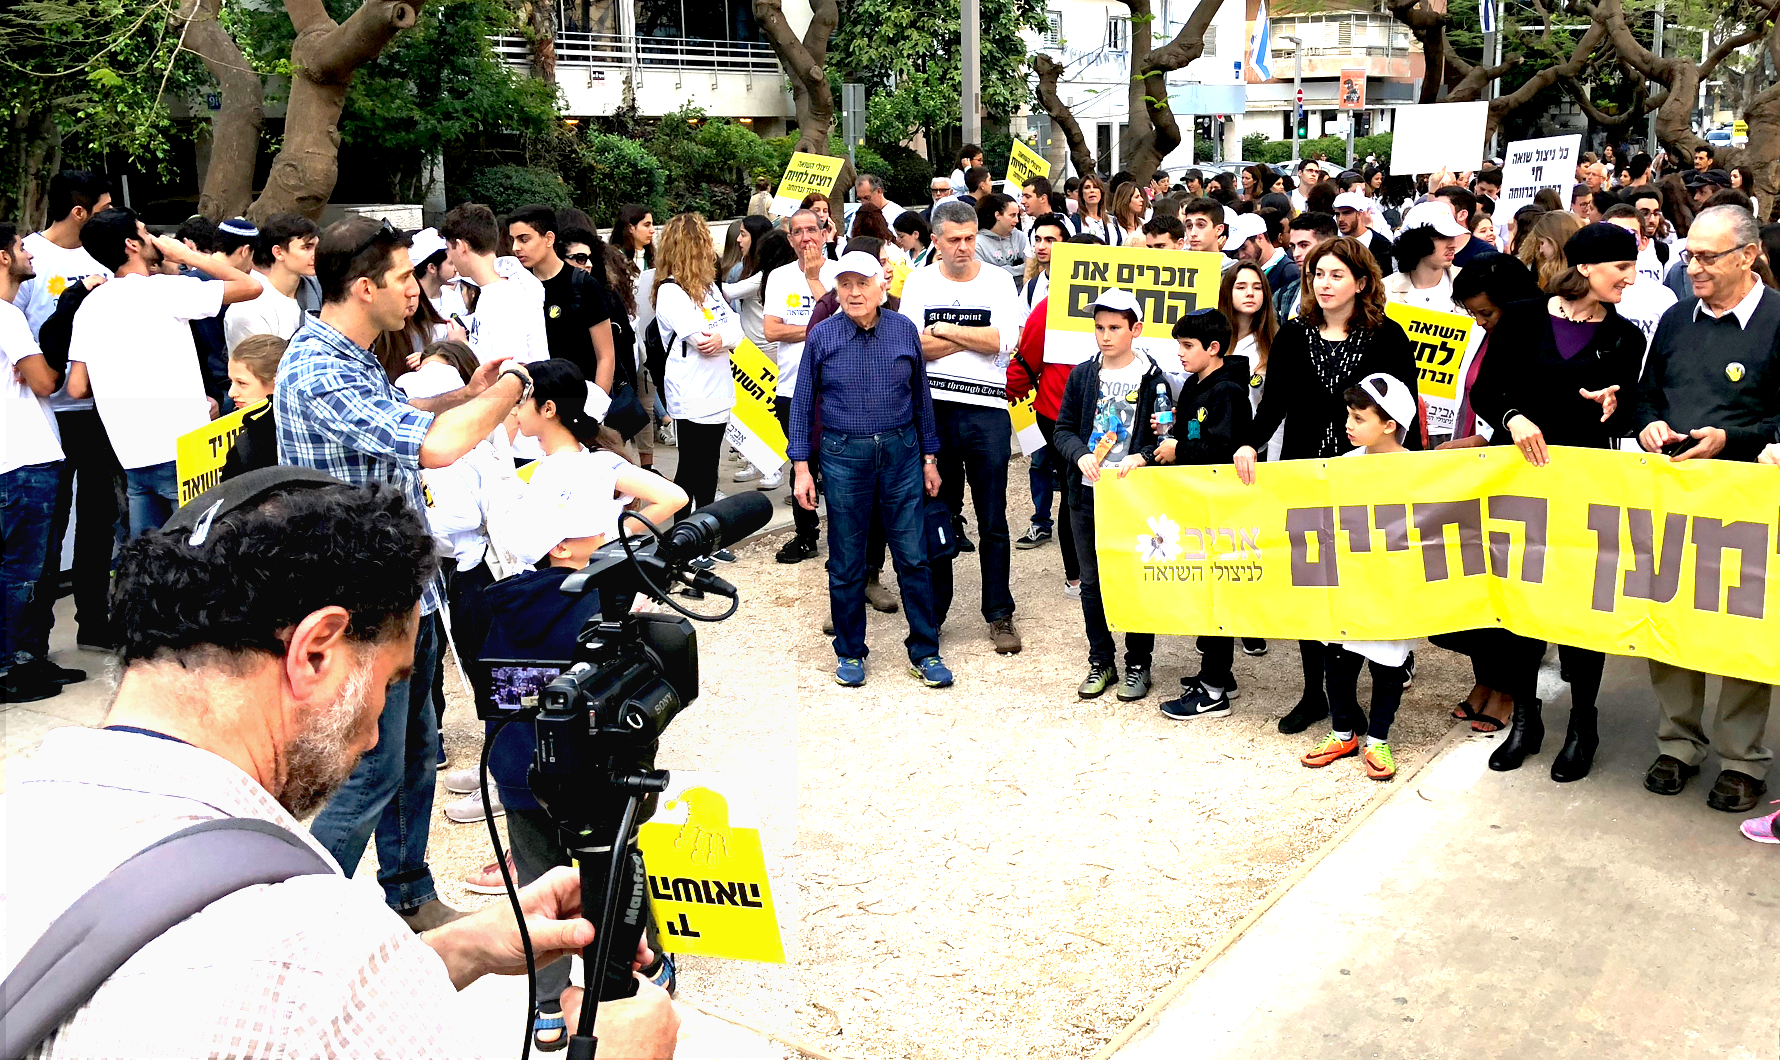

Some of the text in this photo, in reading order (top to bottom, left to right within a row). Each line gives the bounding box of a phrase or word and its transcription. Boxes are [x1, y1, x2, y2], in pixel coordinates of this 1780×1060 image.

[797, 160, 831, 172] ניצולי השואה
[1512, 147, 1569, 164] כל ניצול שואה
[784, 169, 833, 188] רוצים לחיות
[1531, 166, 1543, 182] חי
[1070, 260, 1199, 288] זוכרים את
[1068, 283, 1198, 325] החם
[929, 312, 982, 322] At the point
[1408, 320, 1467, 342] השואה
[1411, 340, 1456, 366] לחי
[729, 358, 766, 401] השוא
[759, 366, 776, 383] יד
[1417, 367, 1454, 385] וברו
[1428, 405, 1455, 419] אביב
[208, 434, 223, 459] יד
[1184, 525, 1263, 560] אביב
[1285, 494, 1780, 620] מען החיים
[1143, 561, 1263, 582] לניצולי השואה
[654, 691, 673, 715] SONY
[623, 852, 645, 926] Manfro
[648, 874, 763, 909] השואה
[666, 912, 701, 938] יד
